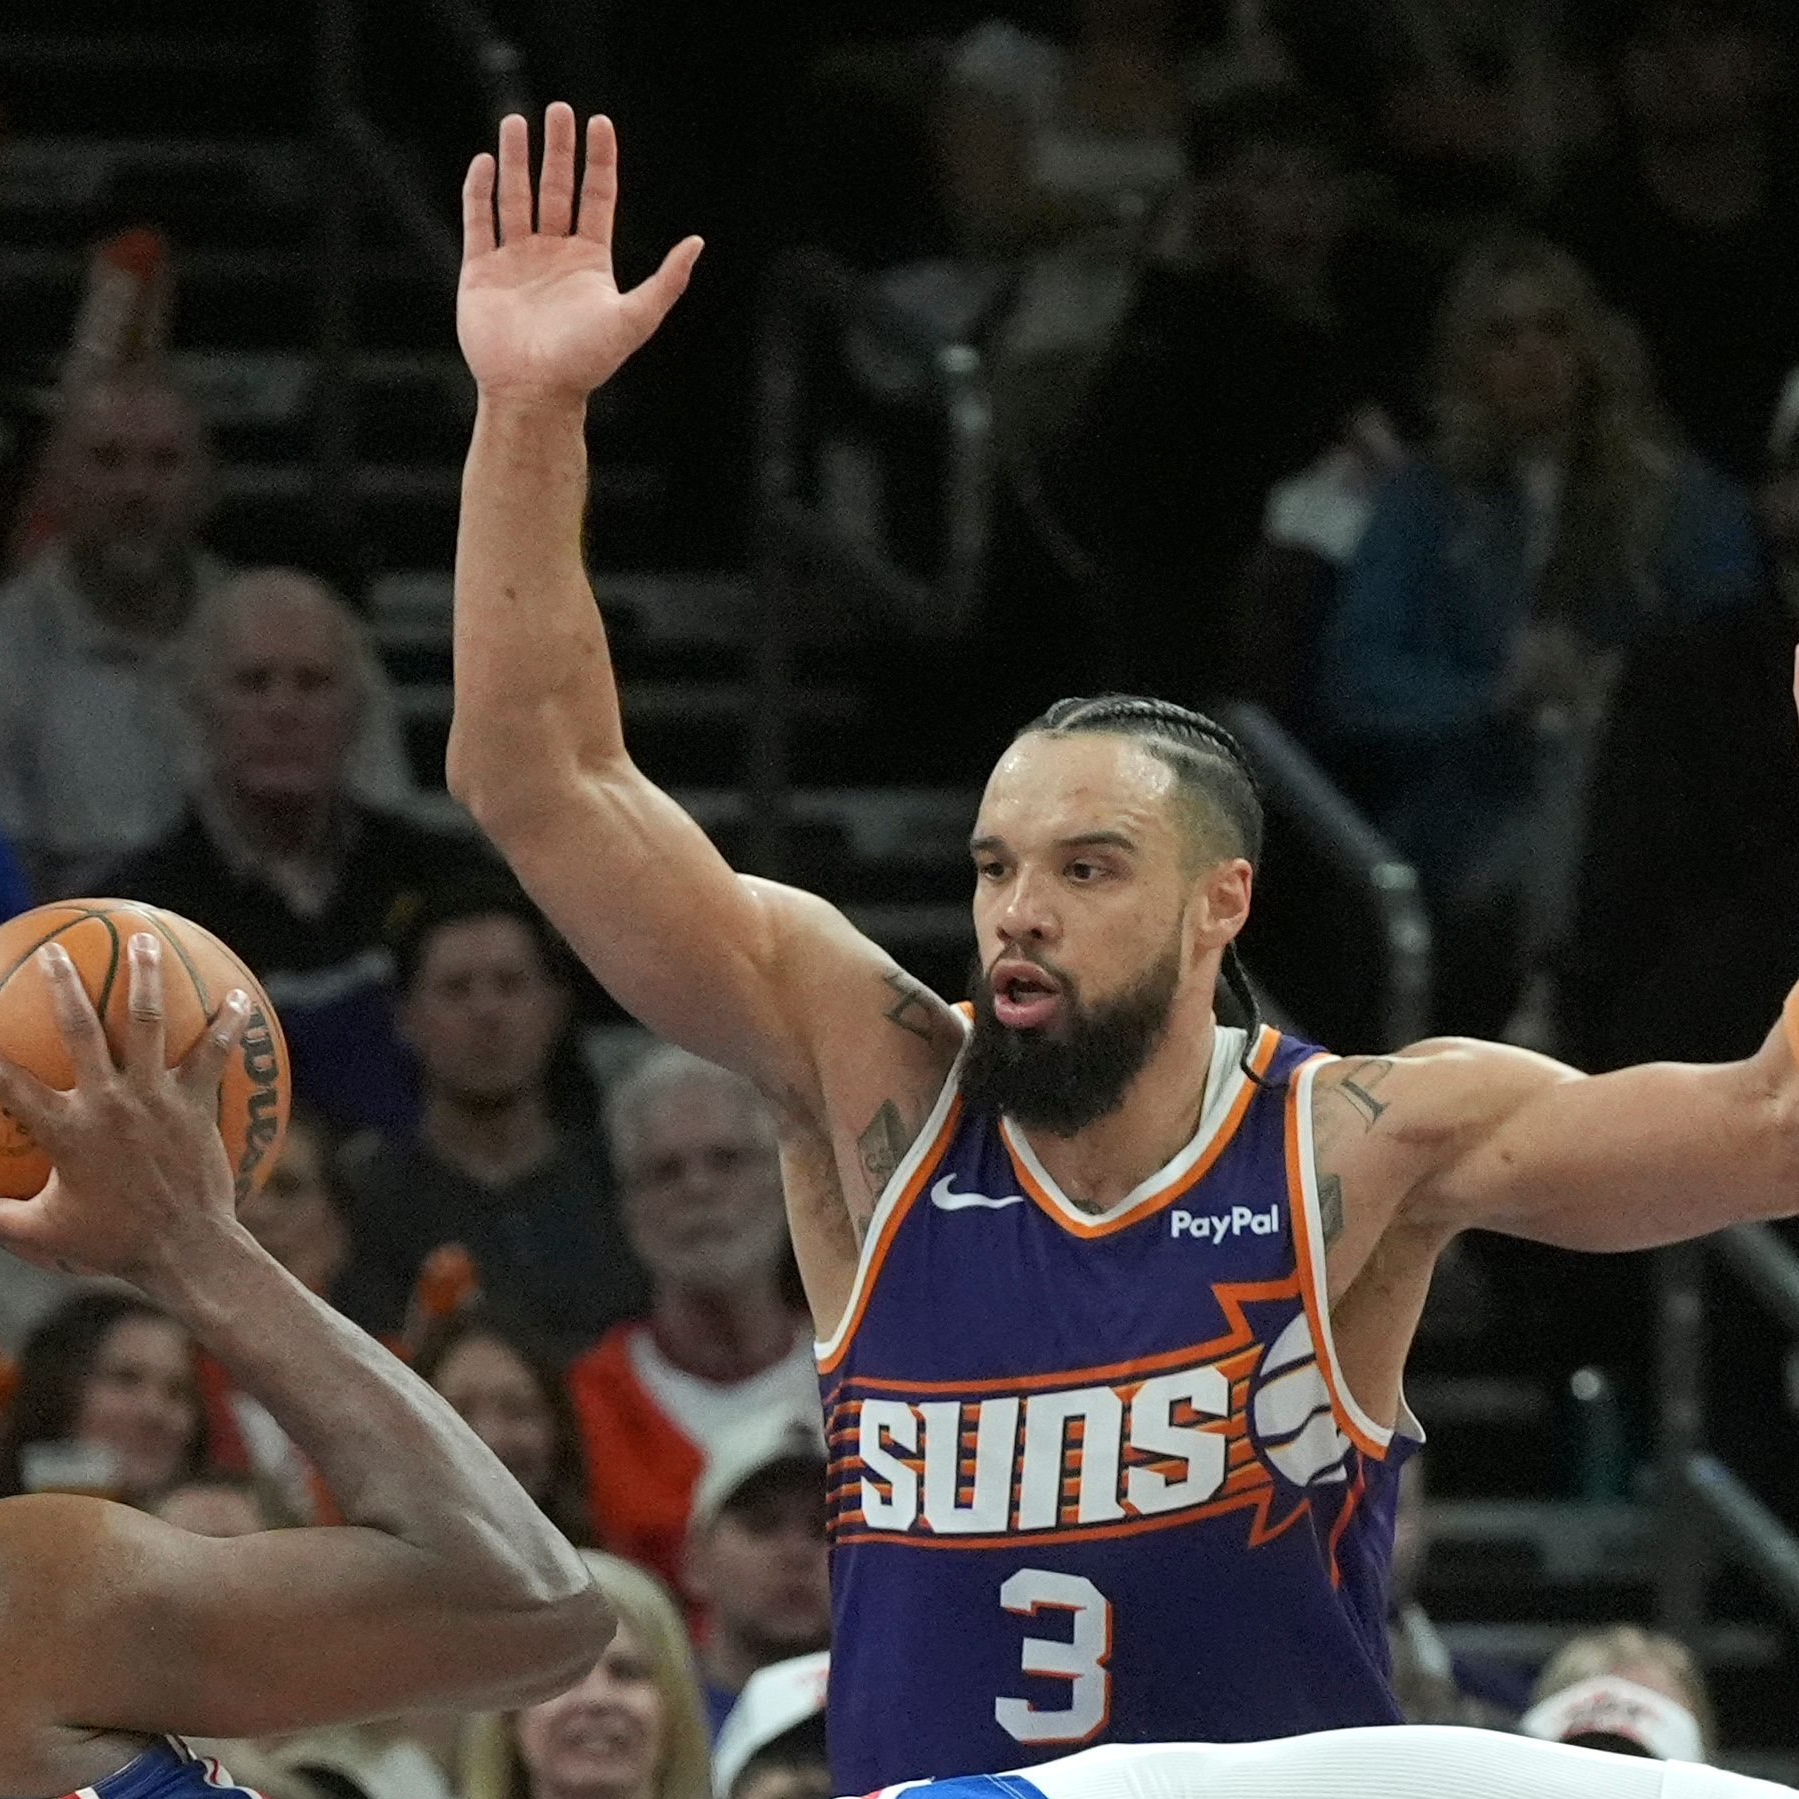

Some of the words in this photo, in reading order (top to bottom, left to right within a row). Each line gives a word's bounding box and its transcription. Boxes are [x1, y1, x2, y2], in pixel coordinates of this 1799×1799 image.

[1170, 1204, 1280, 1245] PayPal
[859, 1366, 1230, 1535] SUNS
[994, 1567, 1114, 1746] 3
